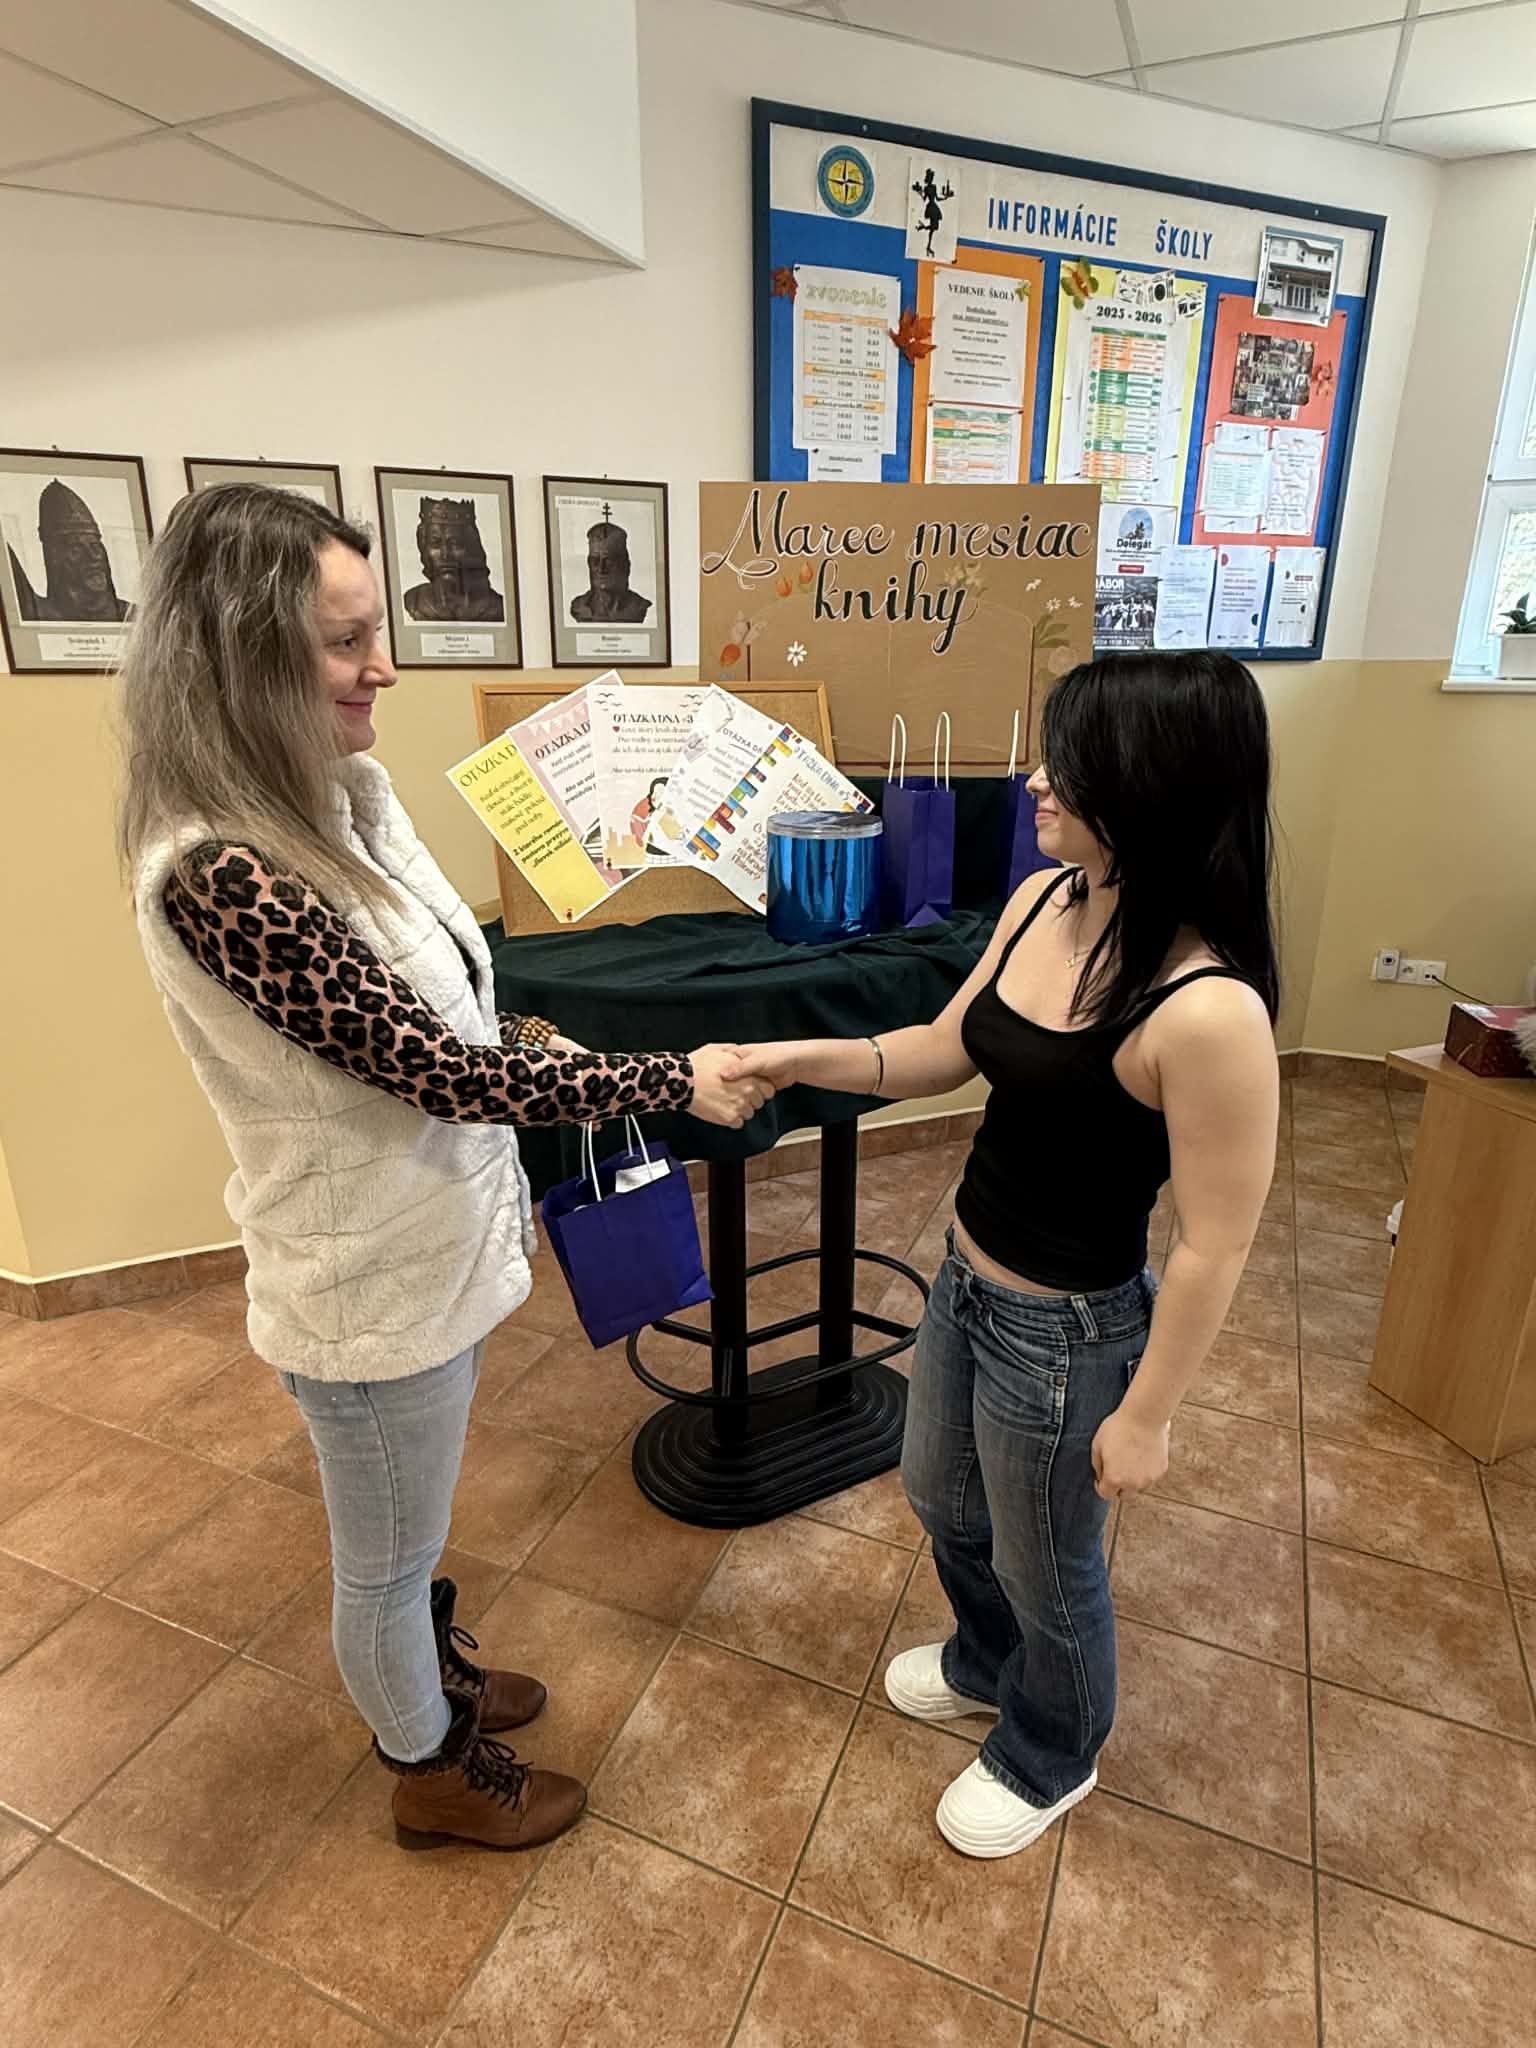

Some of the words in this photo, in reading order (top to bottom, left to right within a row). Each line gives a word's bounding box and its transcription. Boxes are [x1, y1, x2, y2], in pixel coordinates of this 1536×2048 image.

[988, 198, 1118, 246] INFORMÁCIE
[1155, 219, 1213, 261] ŠKOLY
[948, 283, 985, 297] VEDENIE
[989, 287, 1015, 302] ŠKOLY
[1096, 305, 1126, 319] 2025
[1135, 310, 1163, 324] 2026
[702, 488, 894, 580] Marec
[908, 512, 1092, 560] mesiac
[1116, 538, 1152, 550] Delegát
[814, 558, 978, 656] knihy
[580, 720, 592, 735] D
